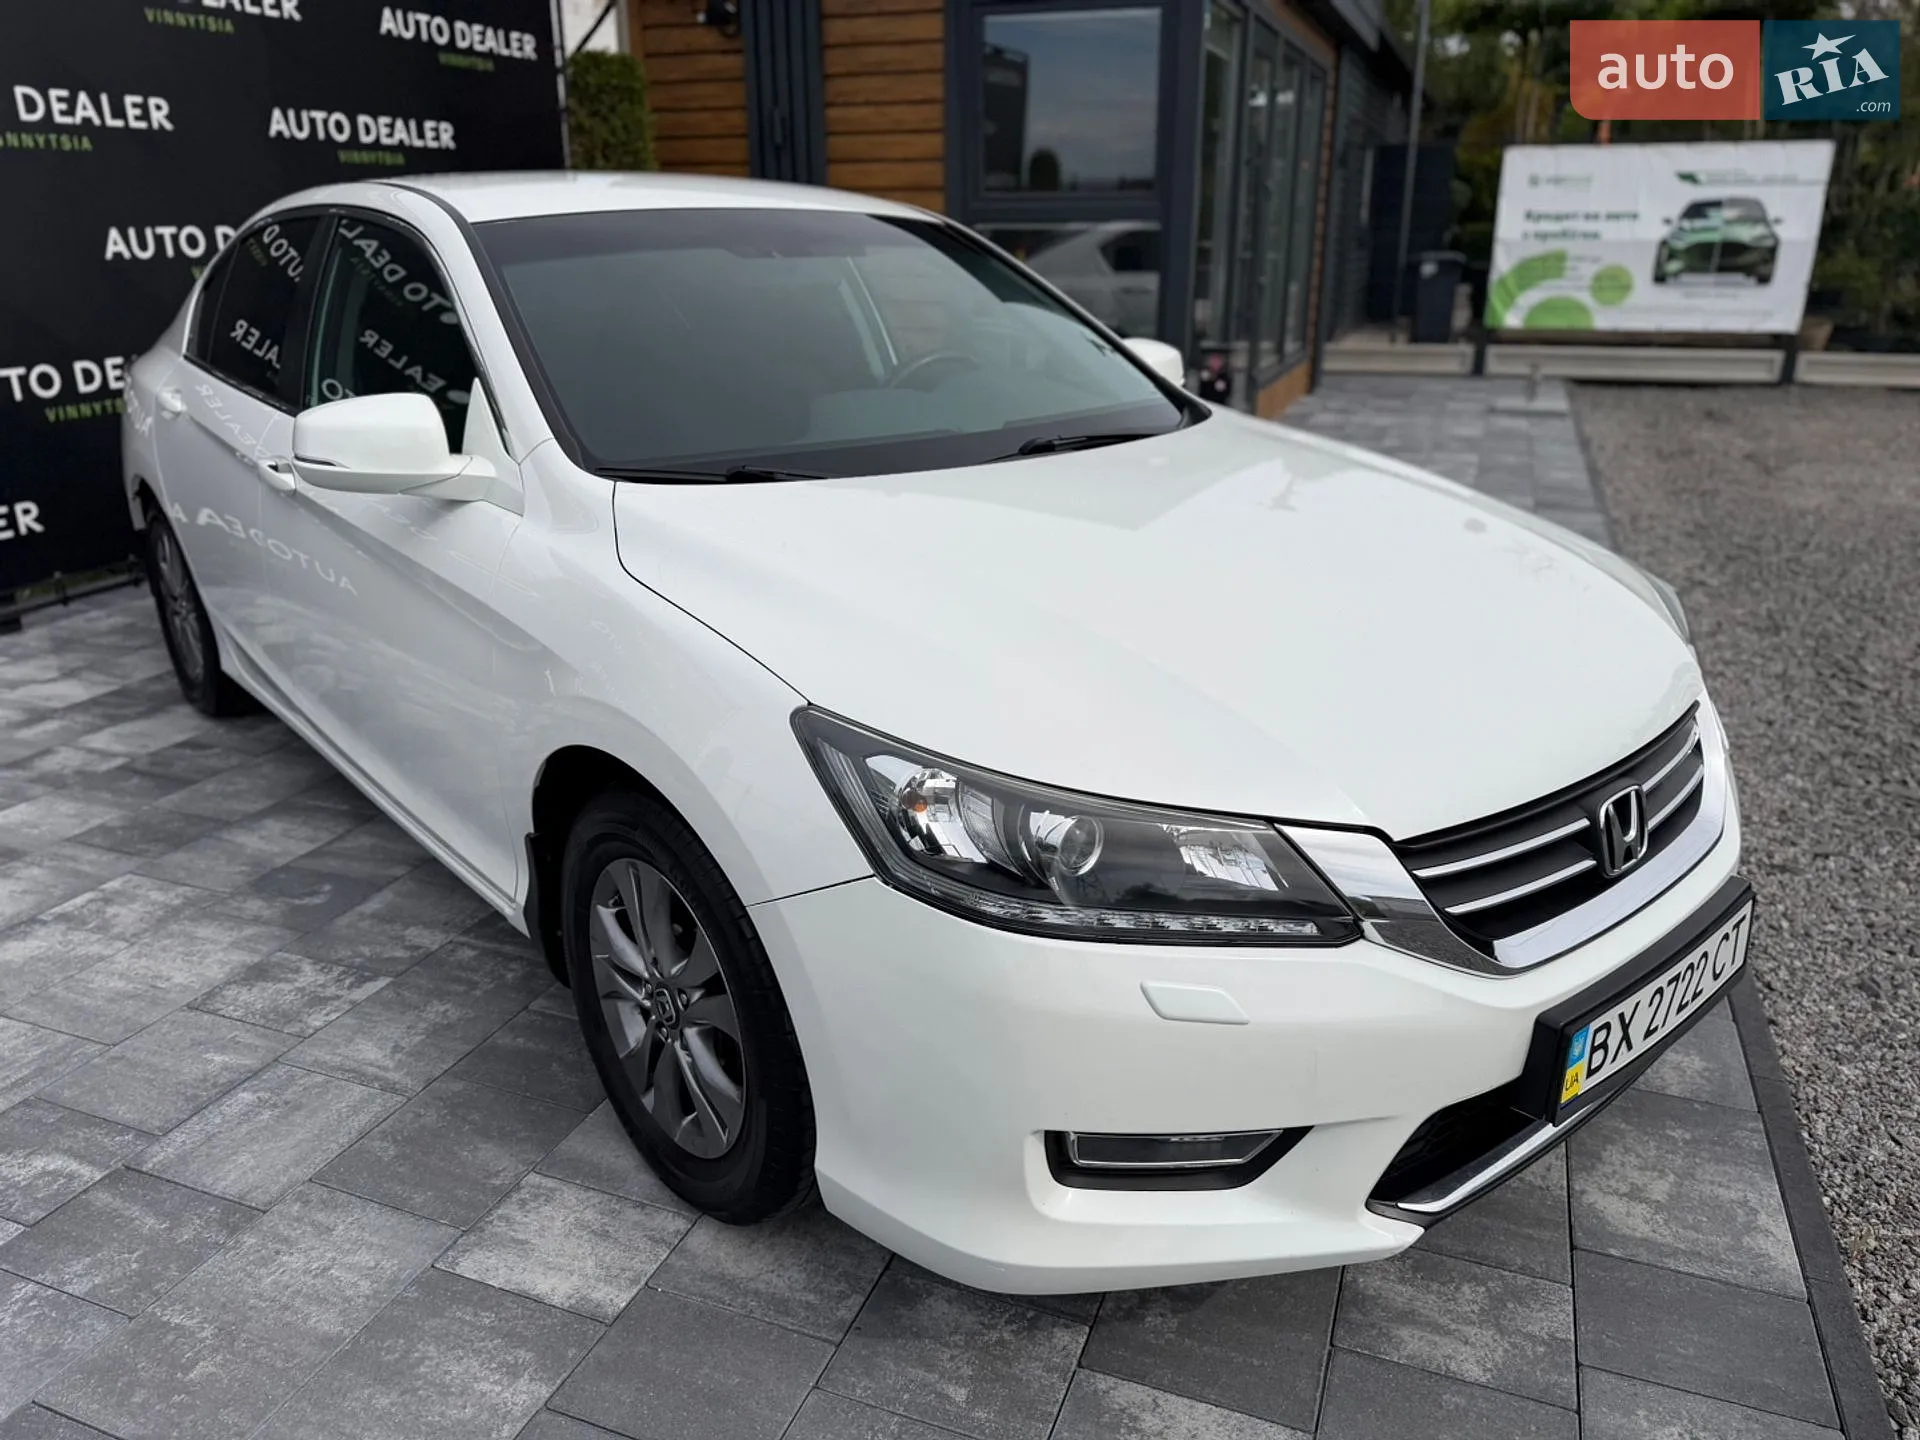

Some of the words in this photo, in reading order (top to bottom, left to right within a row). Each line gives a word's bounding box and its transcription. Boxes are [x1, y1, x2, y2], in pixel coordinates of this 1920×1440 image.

[379, 6, 451, 46] AUTO
[453, 20, 538, 61] DEALER
[13, 84, 174, 131] DEALER
[268, 106, 351, 143] AUTO
[356, 114, 456, 150] DEALER
[0, 131, 93, 151] NNYTSIA
[104, 225, 207, 262] AUTO
[0, 364, 62, 402] TO
[72, 356, 126, 394] DE
[1586, 1000, 1640, 1080] BX
[1643, 951, 1709, 1042] 2722
[1712, 914, 1747, 981] CT
